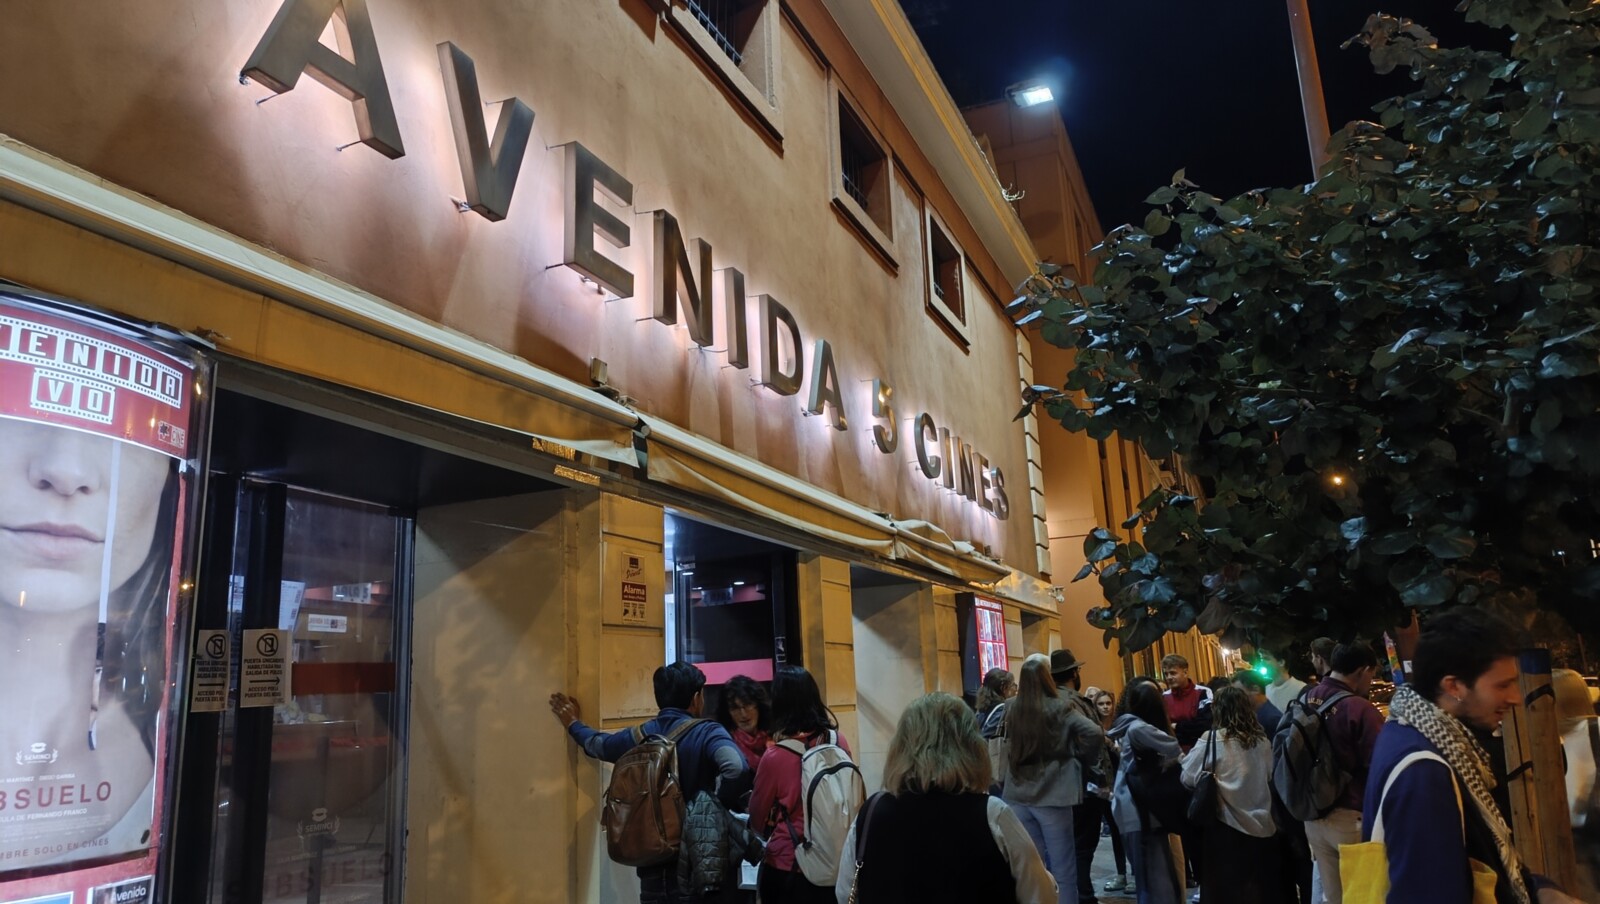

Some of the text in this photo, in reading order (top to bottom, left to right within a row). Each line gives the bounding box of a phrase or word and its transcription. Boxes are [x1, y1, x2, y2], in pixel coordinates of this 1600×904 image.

[241, 0, 1009, 520] AVENIDA 5 CINES
[0, 326, 176, 397] ENIDA
[48, 379, 104, 413] VO
[624, 584, 645, 595] Alarma
[27, 810, 63, 820] FERNANDO
[63, 808, 88, 817] FRANCO
[305, 822, 333, 833] SEMINCI
[34, 844, 63, 856] SOLO
[67, 841, 79, 851] EN
[82, 837, 109, 848] CINES
